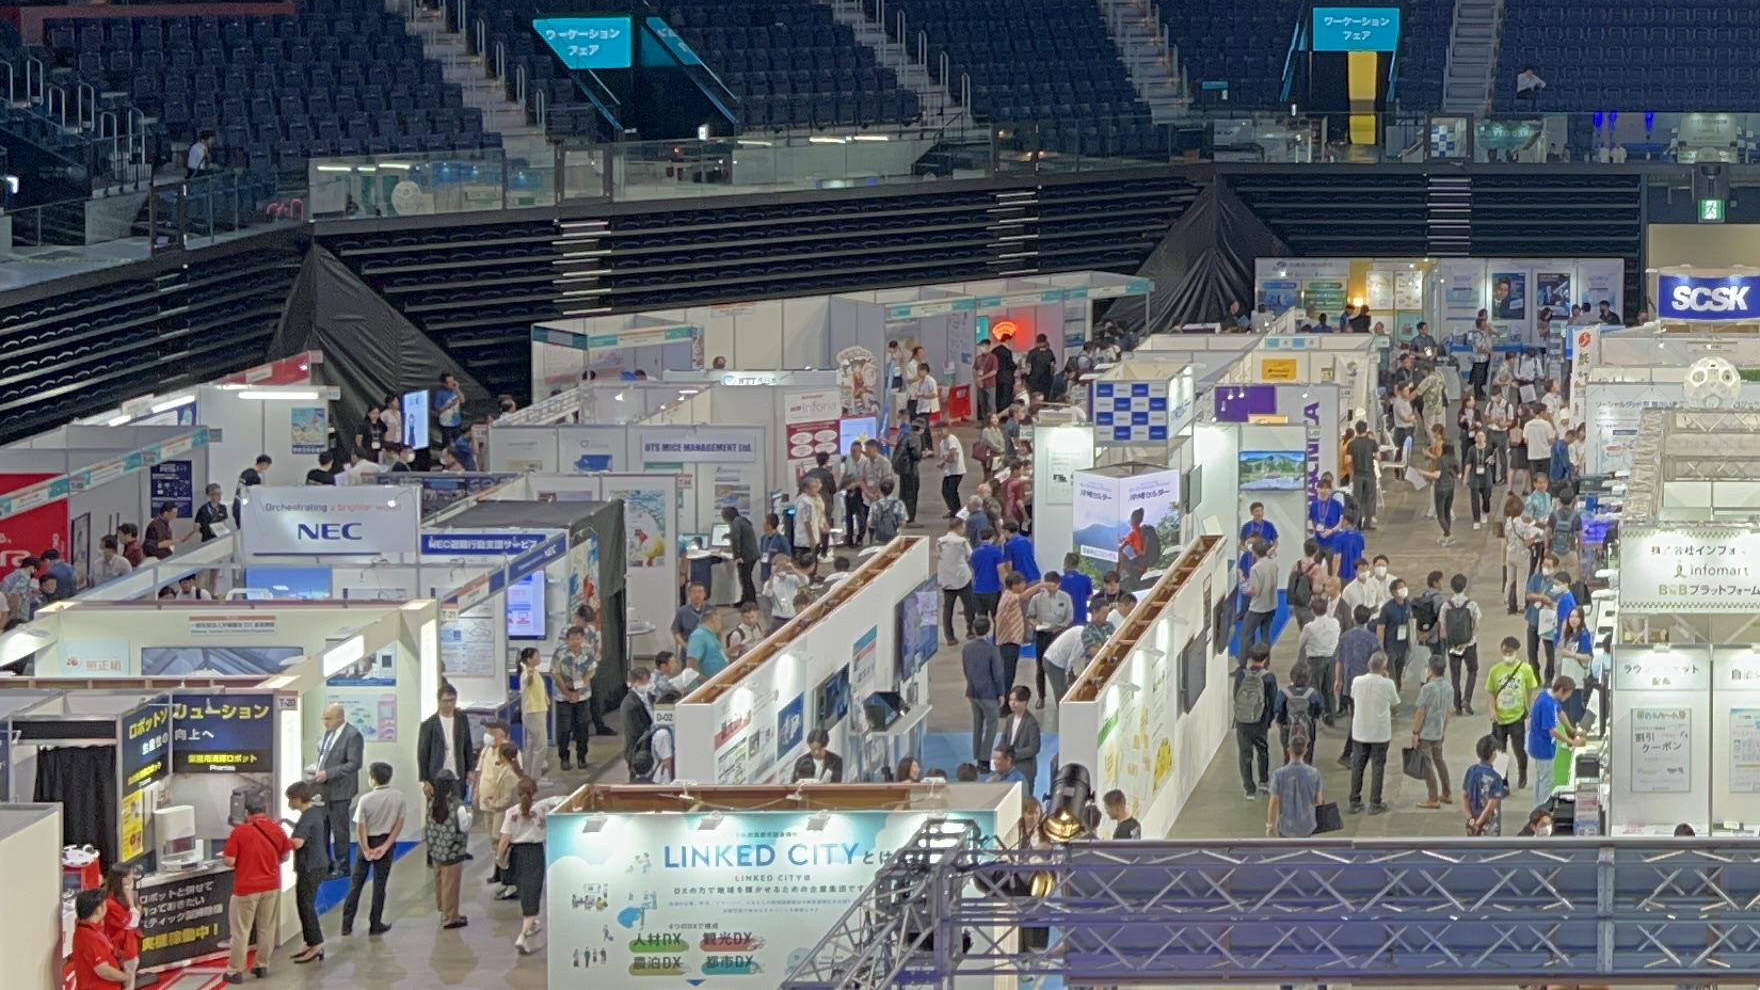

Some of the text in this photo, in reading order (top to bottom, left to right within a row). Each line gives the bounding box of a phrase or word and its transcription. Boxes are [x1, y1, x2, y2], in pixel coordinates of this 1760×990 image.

[1324, 16, 1390, 27] ワーケーション
[1343, 30, 1371, 41] フェア
[568, 44, 599, 57] フェア
[1671, 285, 1751, 312] SCSK
[683, 442, 737, 452] MANAGEMENT
[298, 523, 362, 540] NEC
[1690, 563, 1749, 577] infomart
[664, 844, 776, 868] LINKED
[787, 843, 860, 866] CITY
[734, 874, 774, 882] LINKED
[632, 931, 752, 947] 人材DX 観光DX
[705, 954, 755, 970] 都市DX
